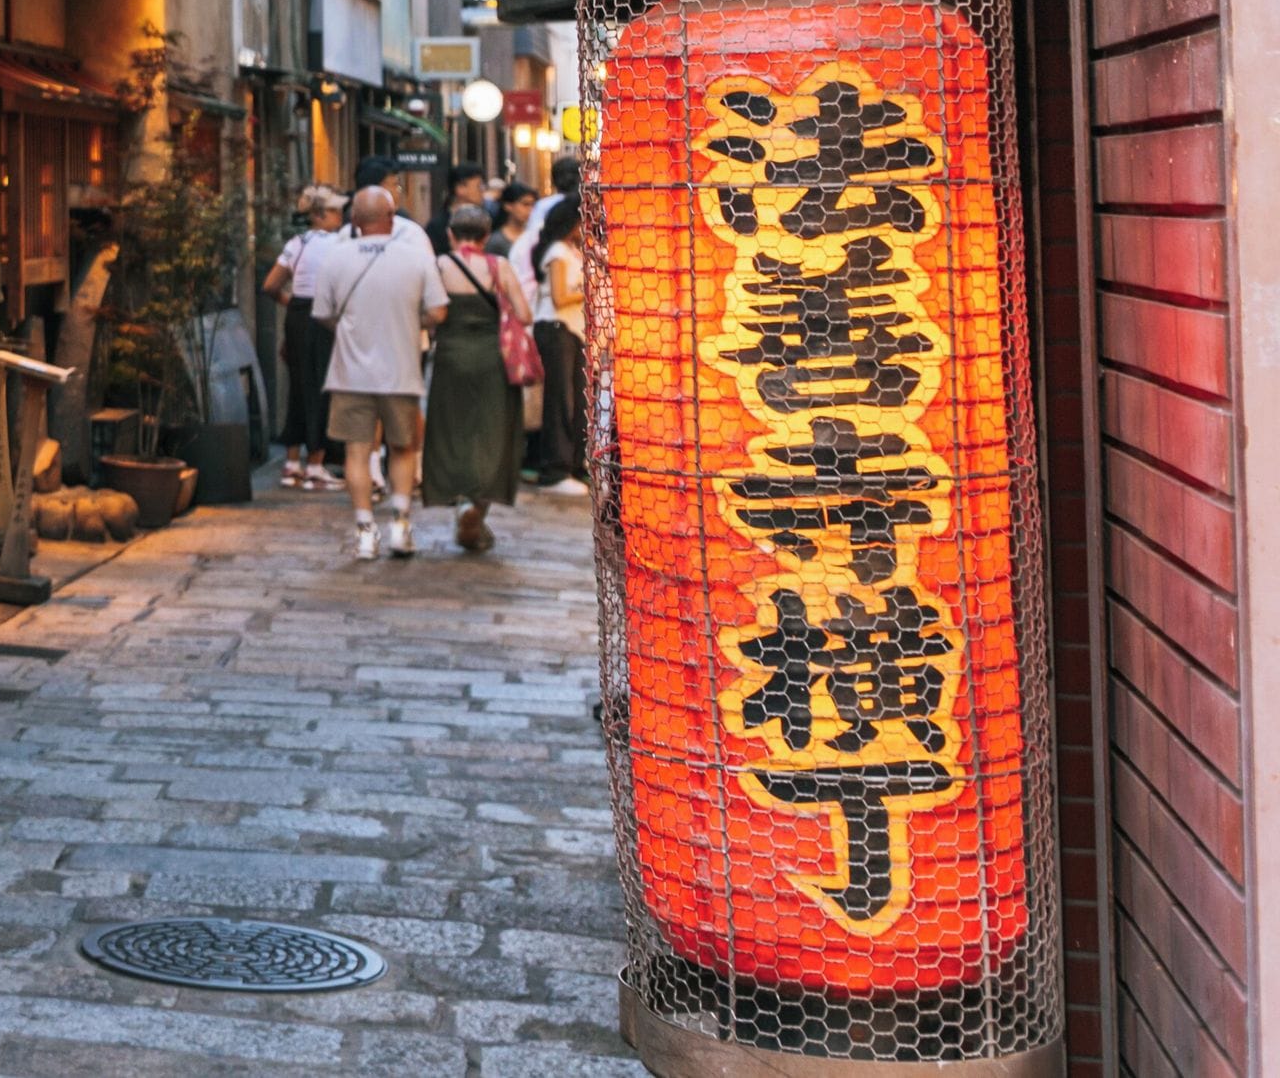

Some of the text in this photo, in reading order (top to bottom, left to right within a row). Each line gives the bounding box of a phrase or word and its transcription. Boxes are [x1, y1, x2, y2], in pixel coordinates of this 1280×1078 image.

[705, 75, 955, 924] 法善寺横丁
